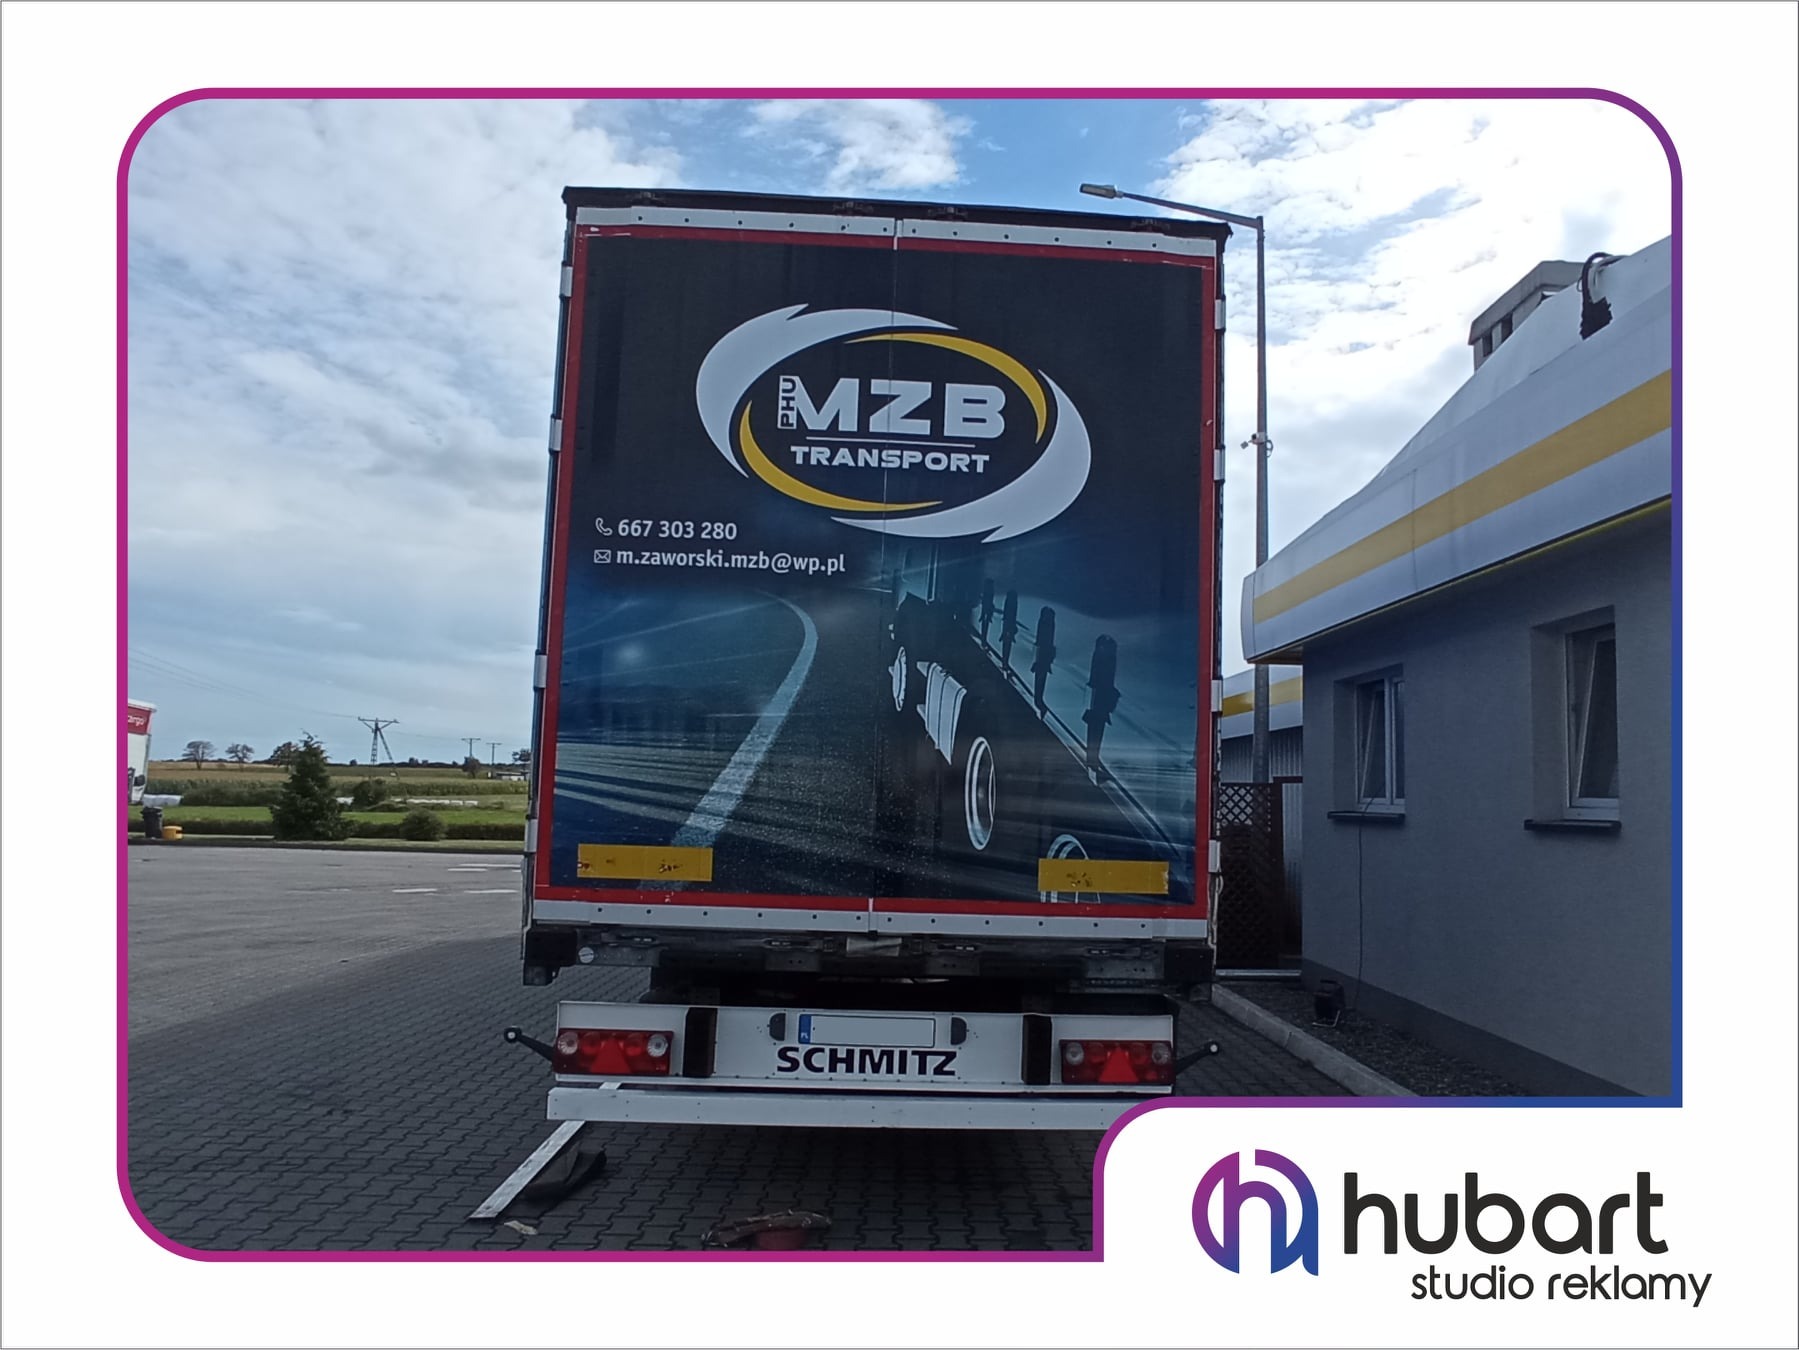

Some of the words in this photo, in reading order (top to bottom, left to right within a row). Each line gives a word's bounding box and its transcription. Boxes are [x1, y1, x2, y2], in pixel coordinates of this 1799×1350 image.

[779, 376, 797, 429] PHU
[796, 376, 1007, 439] MZB
[790, 445, 990, 474] TRANSPORT
[617, 518, 653, 537] 667
[658, 519, 695, 539] 303
[700, 521, 738, 541] 280
[616, 548, 846, 576] m.zaworski.mzb@wp.pl
[776, 1046, 957, 1076] SCHMITZ
